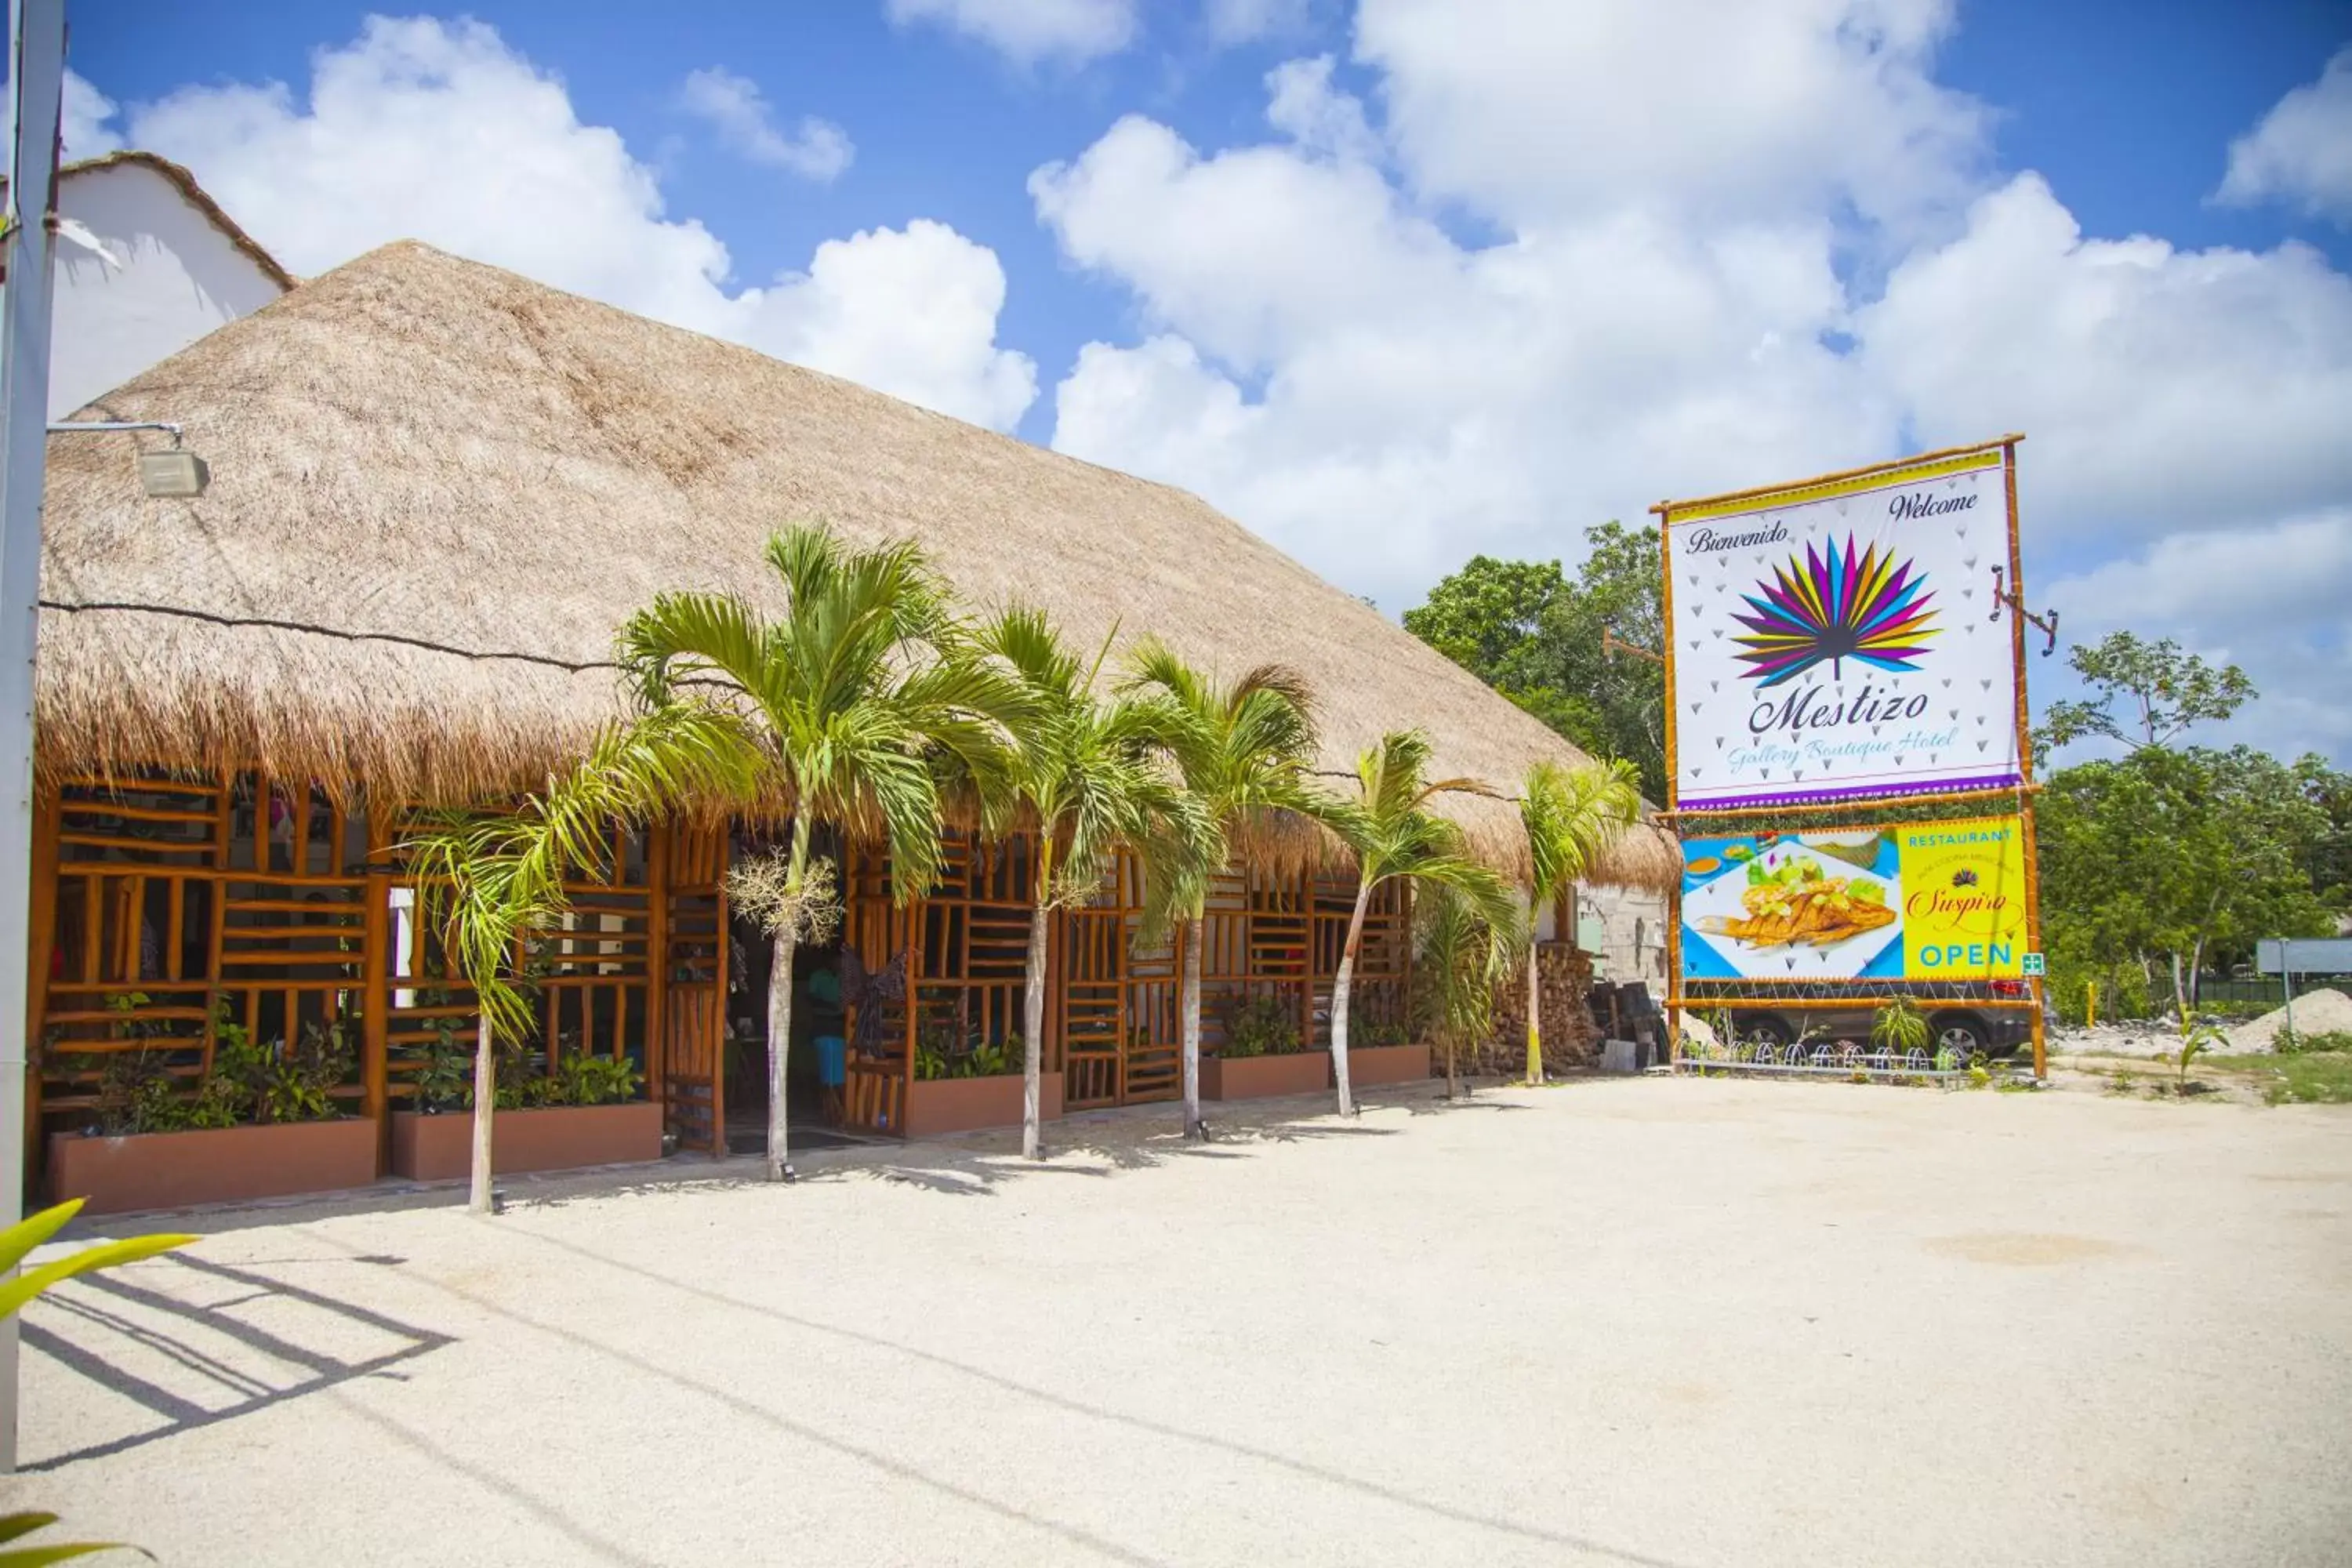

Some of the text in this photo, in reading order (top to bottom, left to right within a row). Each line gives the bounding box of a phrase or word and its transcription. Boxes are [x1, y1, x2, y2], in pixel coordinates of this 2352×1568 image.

[1889, 493, 1979, 521] Welcome
[1686, 520, 1788, 554] Bienvenido
[1748, 684, 1928, 734] Mestizo
[1726, 726, 1958, 775] Gallery Boutique Hotel
[1909, 829, 2011, 848] RESTAURANT
[1907, 890, 2024, 935] Suspiro
[1920, 943, 2011, 967] OPEN
